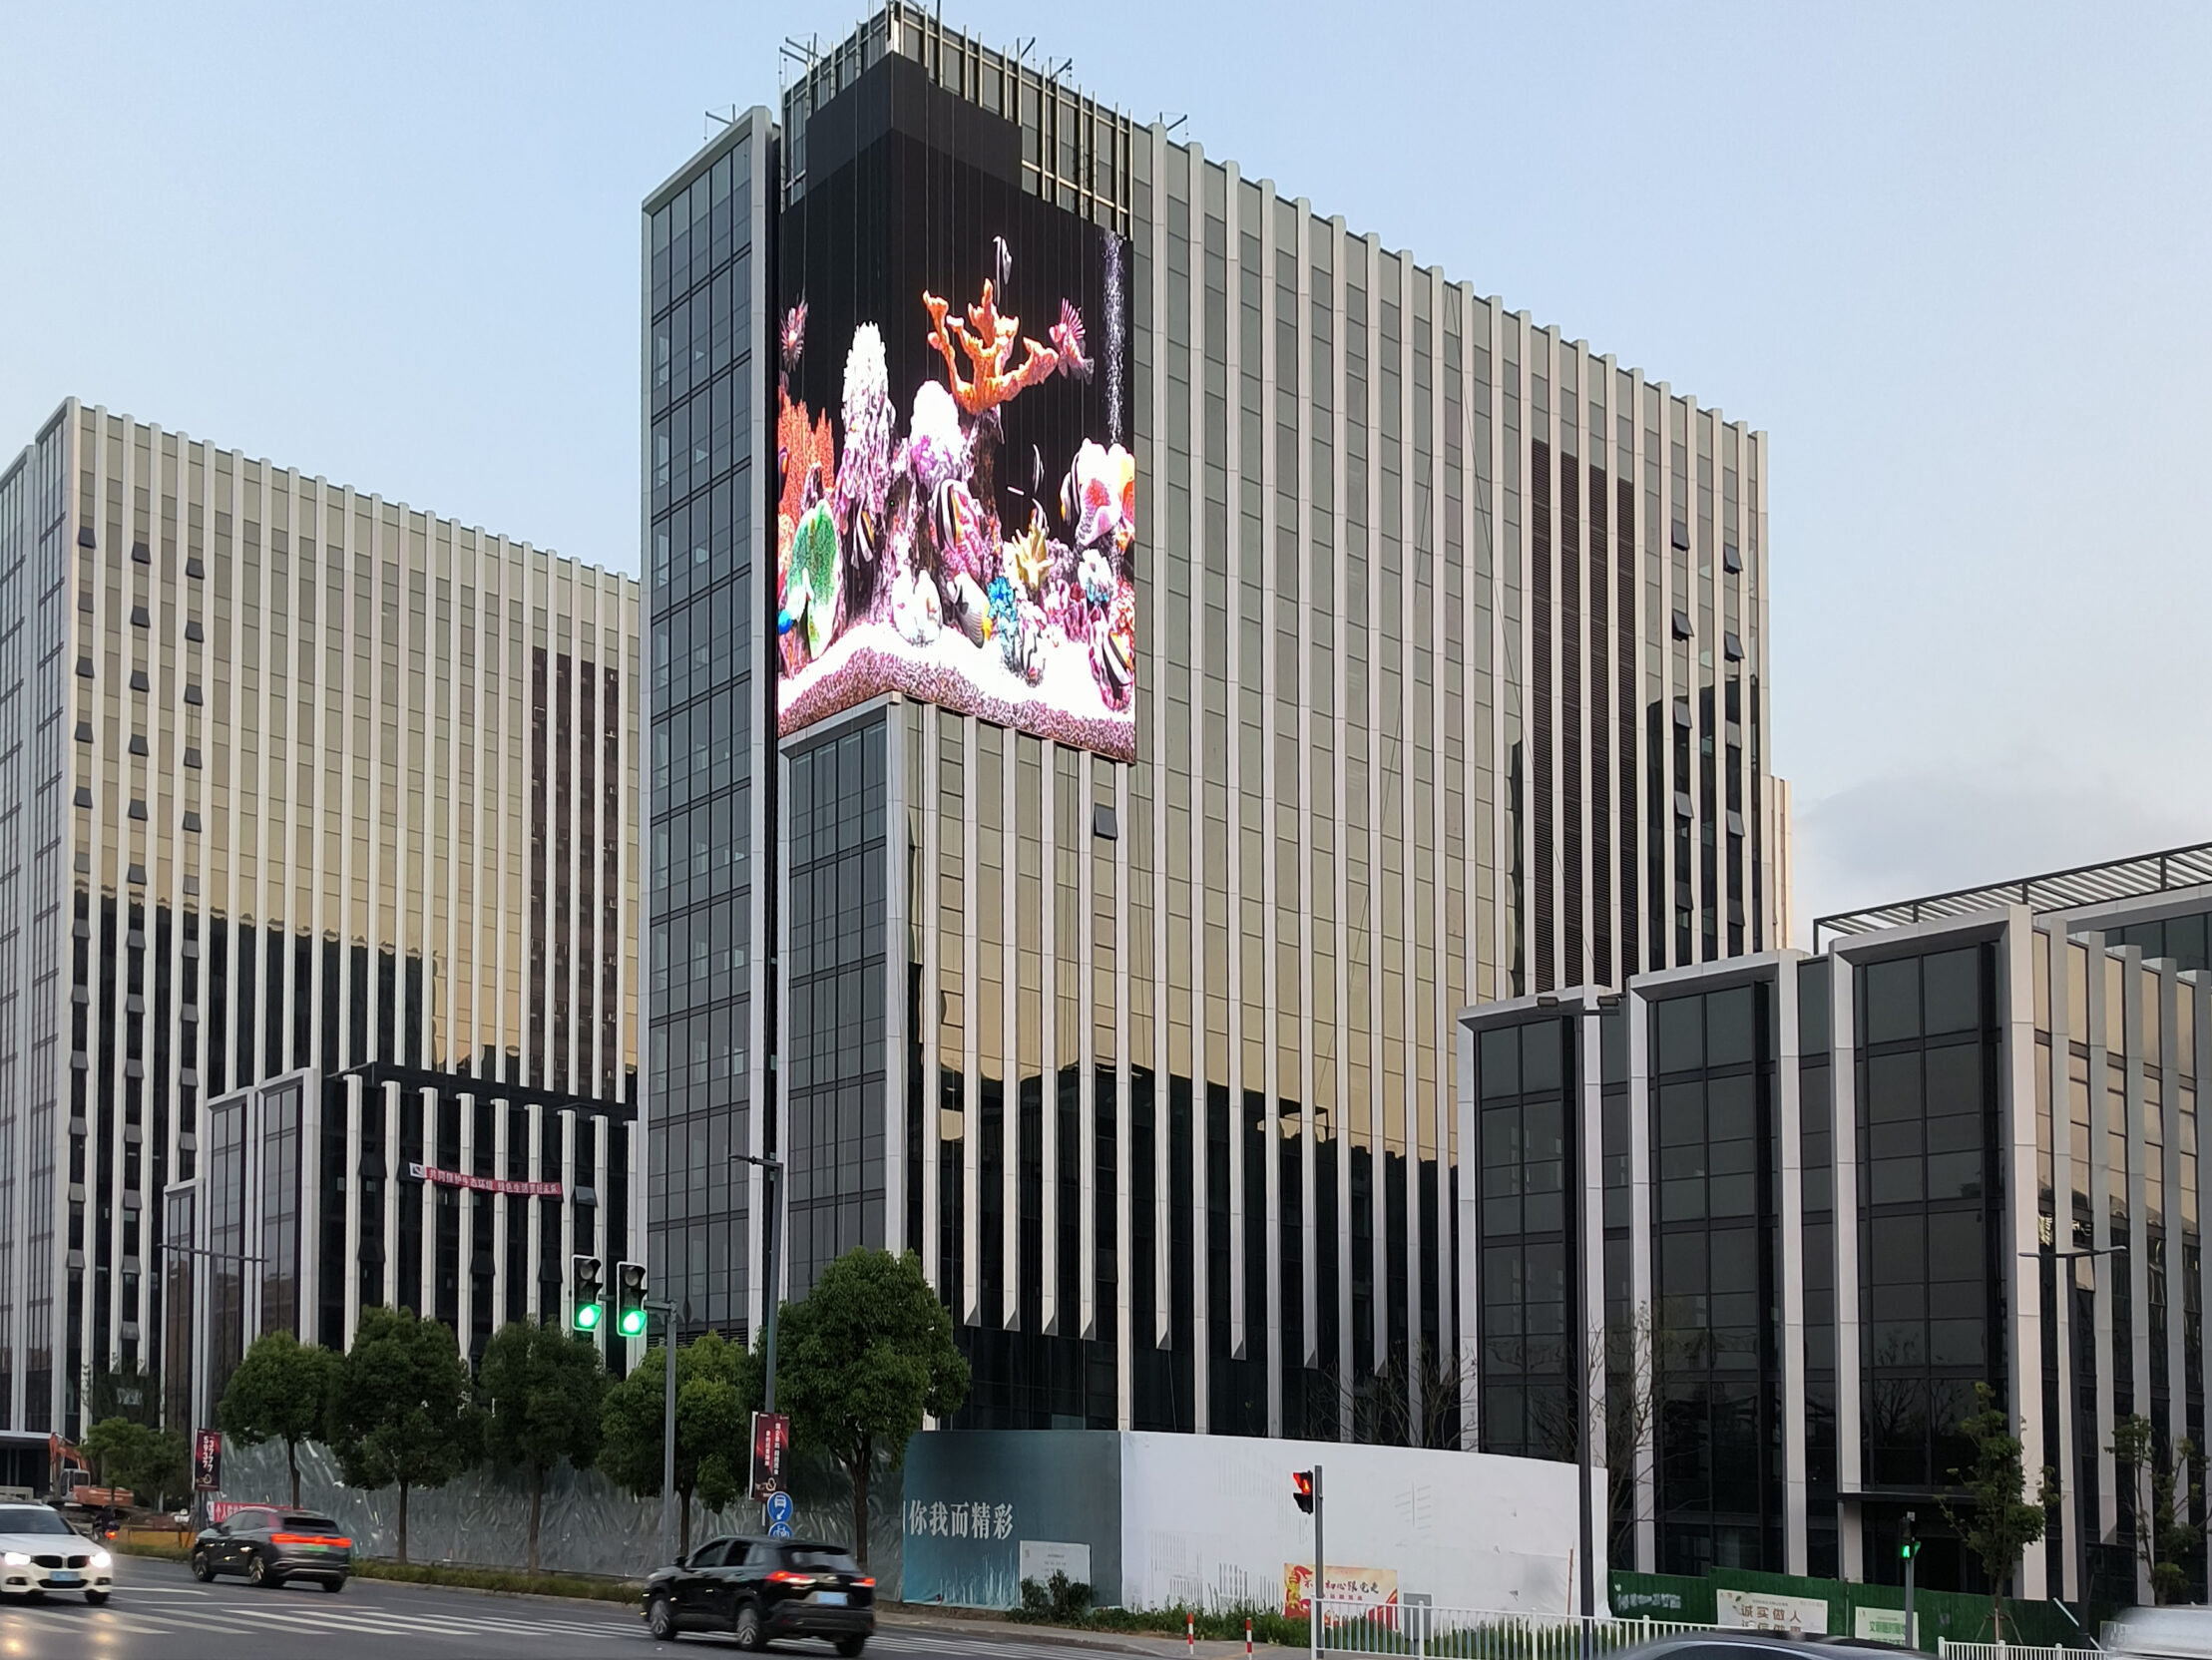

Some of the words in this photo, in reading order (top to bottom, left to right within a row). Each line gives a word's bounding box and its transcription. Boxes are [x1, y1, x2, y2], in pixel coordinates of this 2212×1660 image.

[903, 1499, 1013, 1539] 你我而精彩
[1304, 1578, 1379, 1594] 不初心跟党走
[1741, 1604, 1802, 1623] 诚实做人
